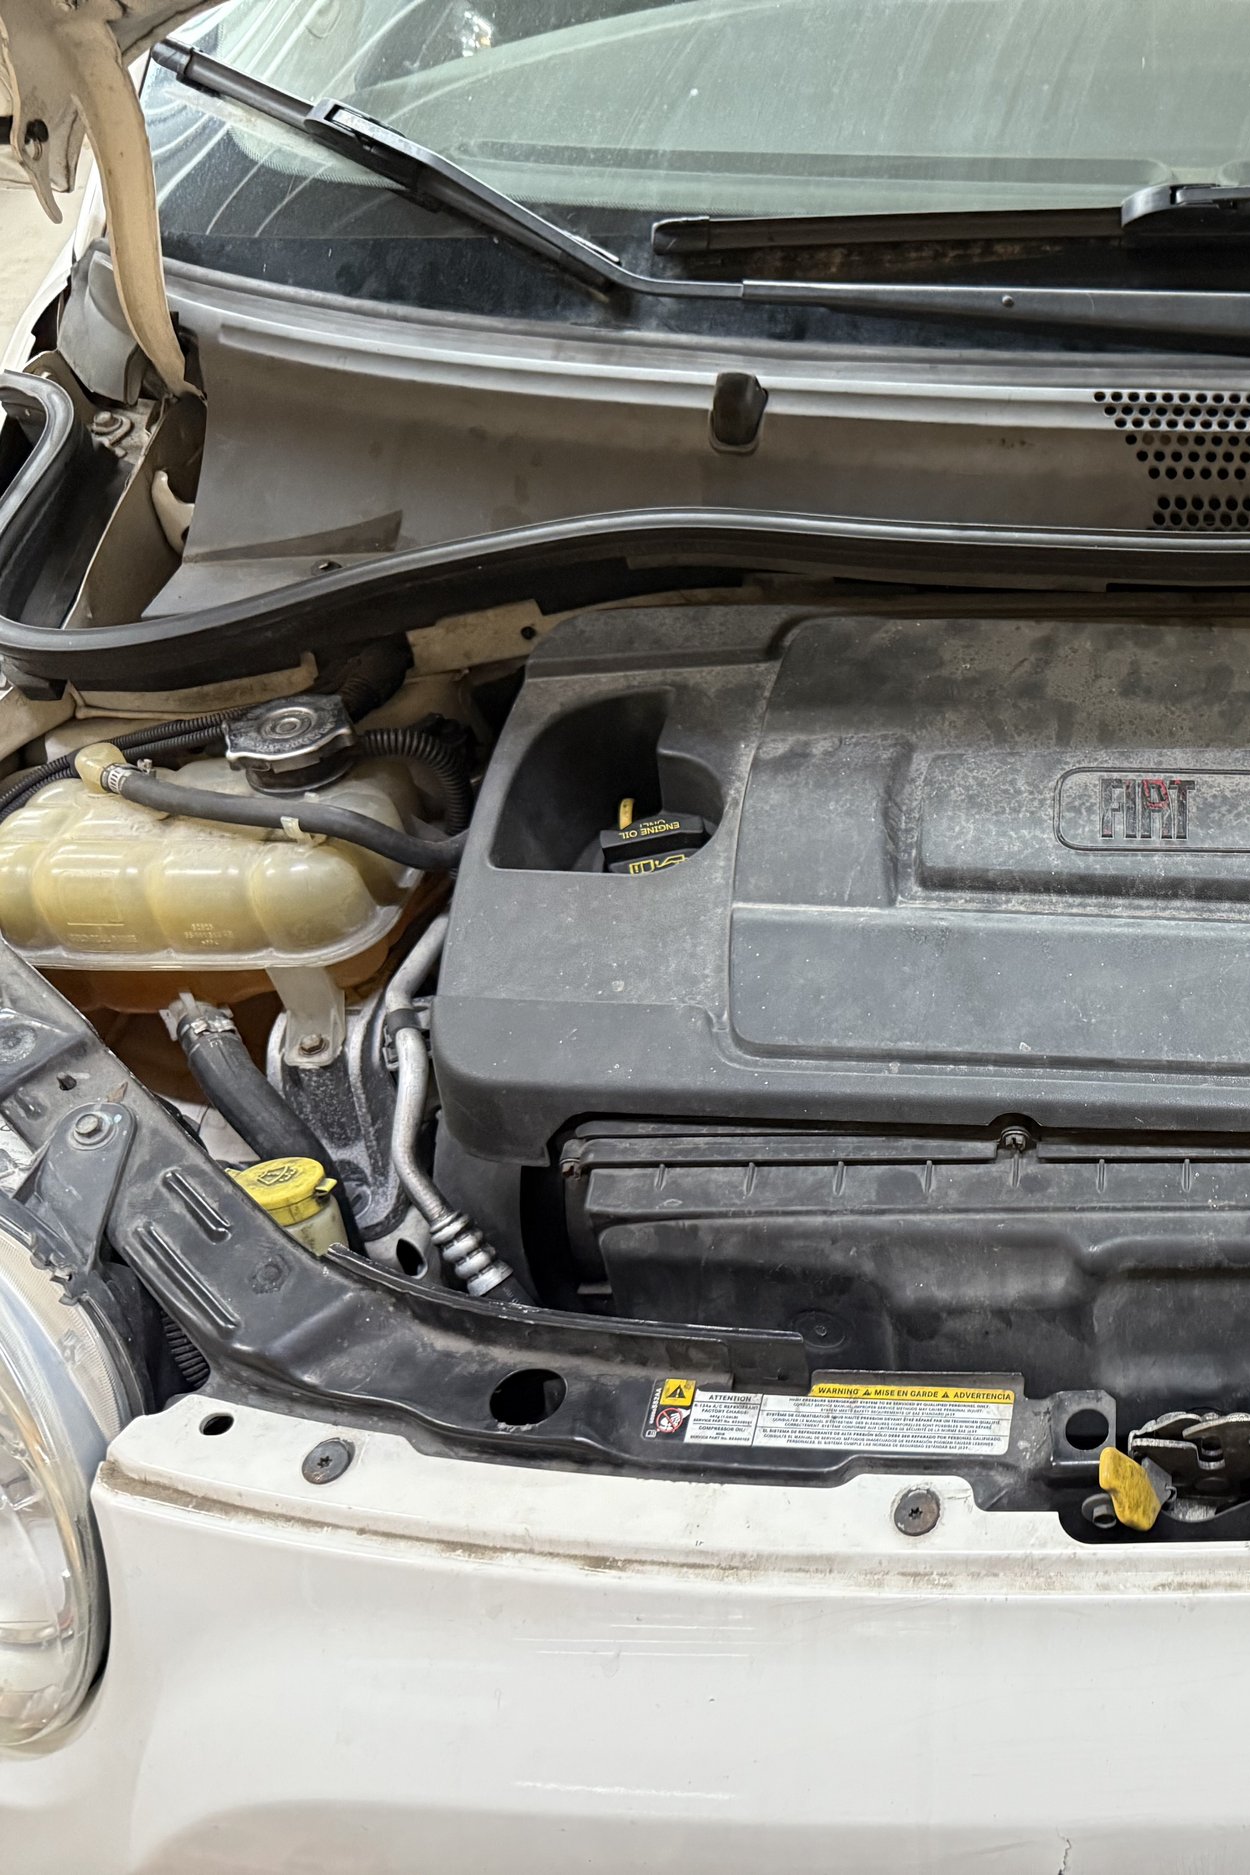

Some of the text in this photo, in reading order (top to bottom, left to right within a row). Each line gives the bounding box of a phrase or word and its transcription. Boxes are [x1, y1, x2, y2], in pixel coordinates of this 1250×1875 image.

[1100, 778, 1195, 840] FIAT
[619, 821, 680, 839] ENGINE OIL
[708, 1394, 752, 1402] ATTENTION
[818, 1386, 859, 1395] WARNING
[874, 1388, 895, 1396] MISE
[910, 1389, 938, 1397] GARDE
[953, 1391, 1010, 1400] ADVERTENCIA
